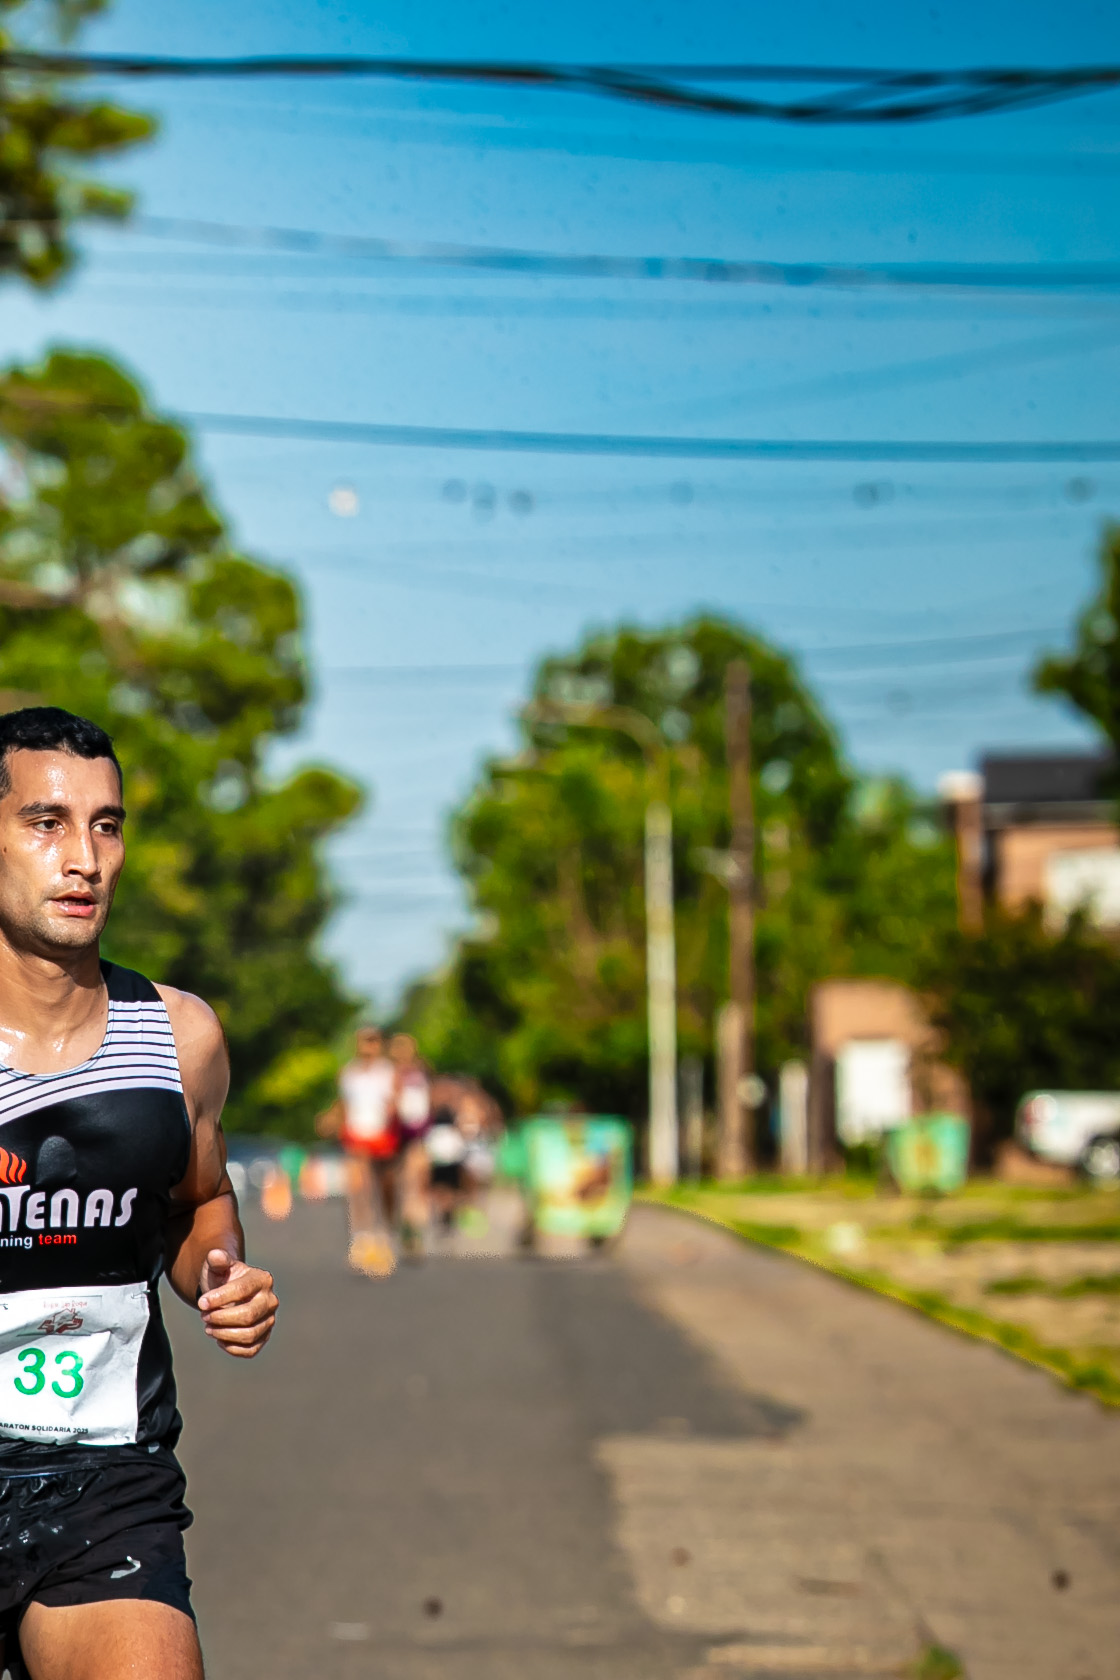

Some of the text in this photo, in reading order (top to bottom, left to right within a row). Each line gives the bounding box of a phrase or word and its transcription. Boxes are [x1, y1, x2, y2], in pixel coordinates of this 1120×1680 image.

[38, 1234, 77, 1245] team
[14, 1347, 84, 1398] 33
[31, 1424, 71, 1433] SOLIDARIA
